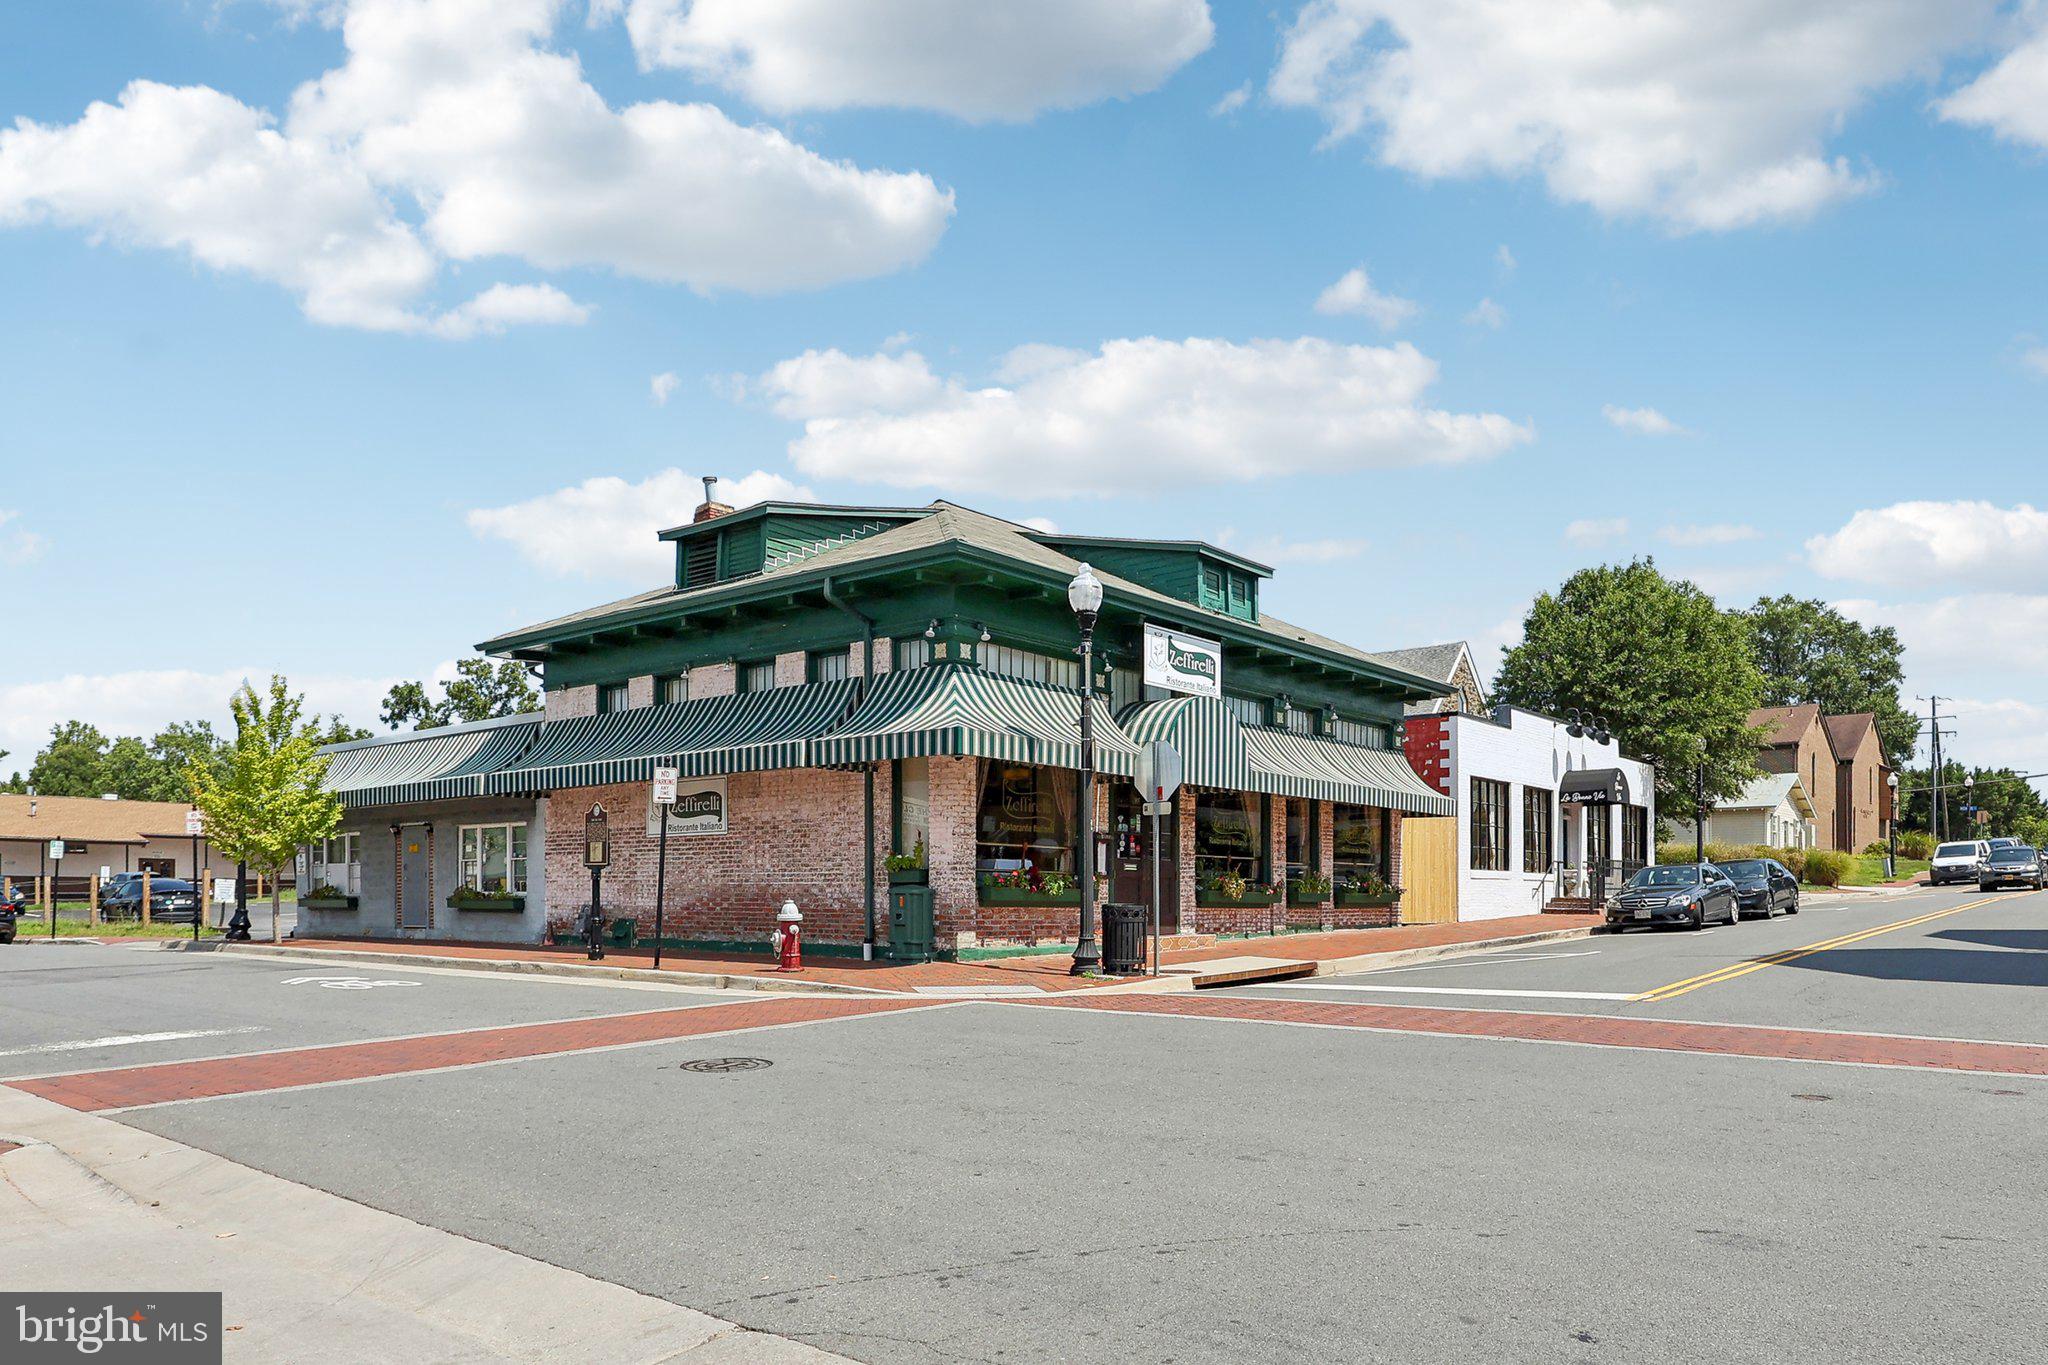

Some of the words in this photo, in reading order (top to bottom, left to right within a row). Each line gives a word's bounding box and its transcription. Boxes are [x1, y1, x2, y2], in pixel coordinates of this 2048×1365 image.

[1169, 650, 1214, 674] Zeffirelli
[1166, 676, 1196, 689] Ristorante
[661, 770, 670, 778] NO
[671, 795, 720, 812] Zeffirelli
[667, 823, 699, 832] Ristorante
[699, 821, 723, 831] Italiano
